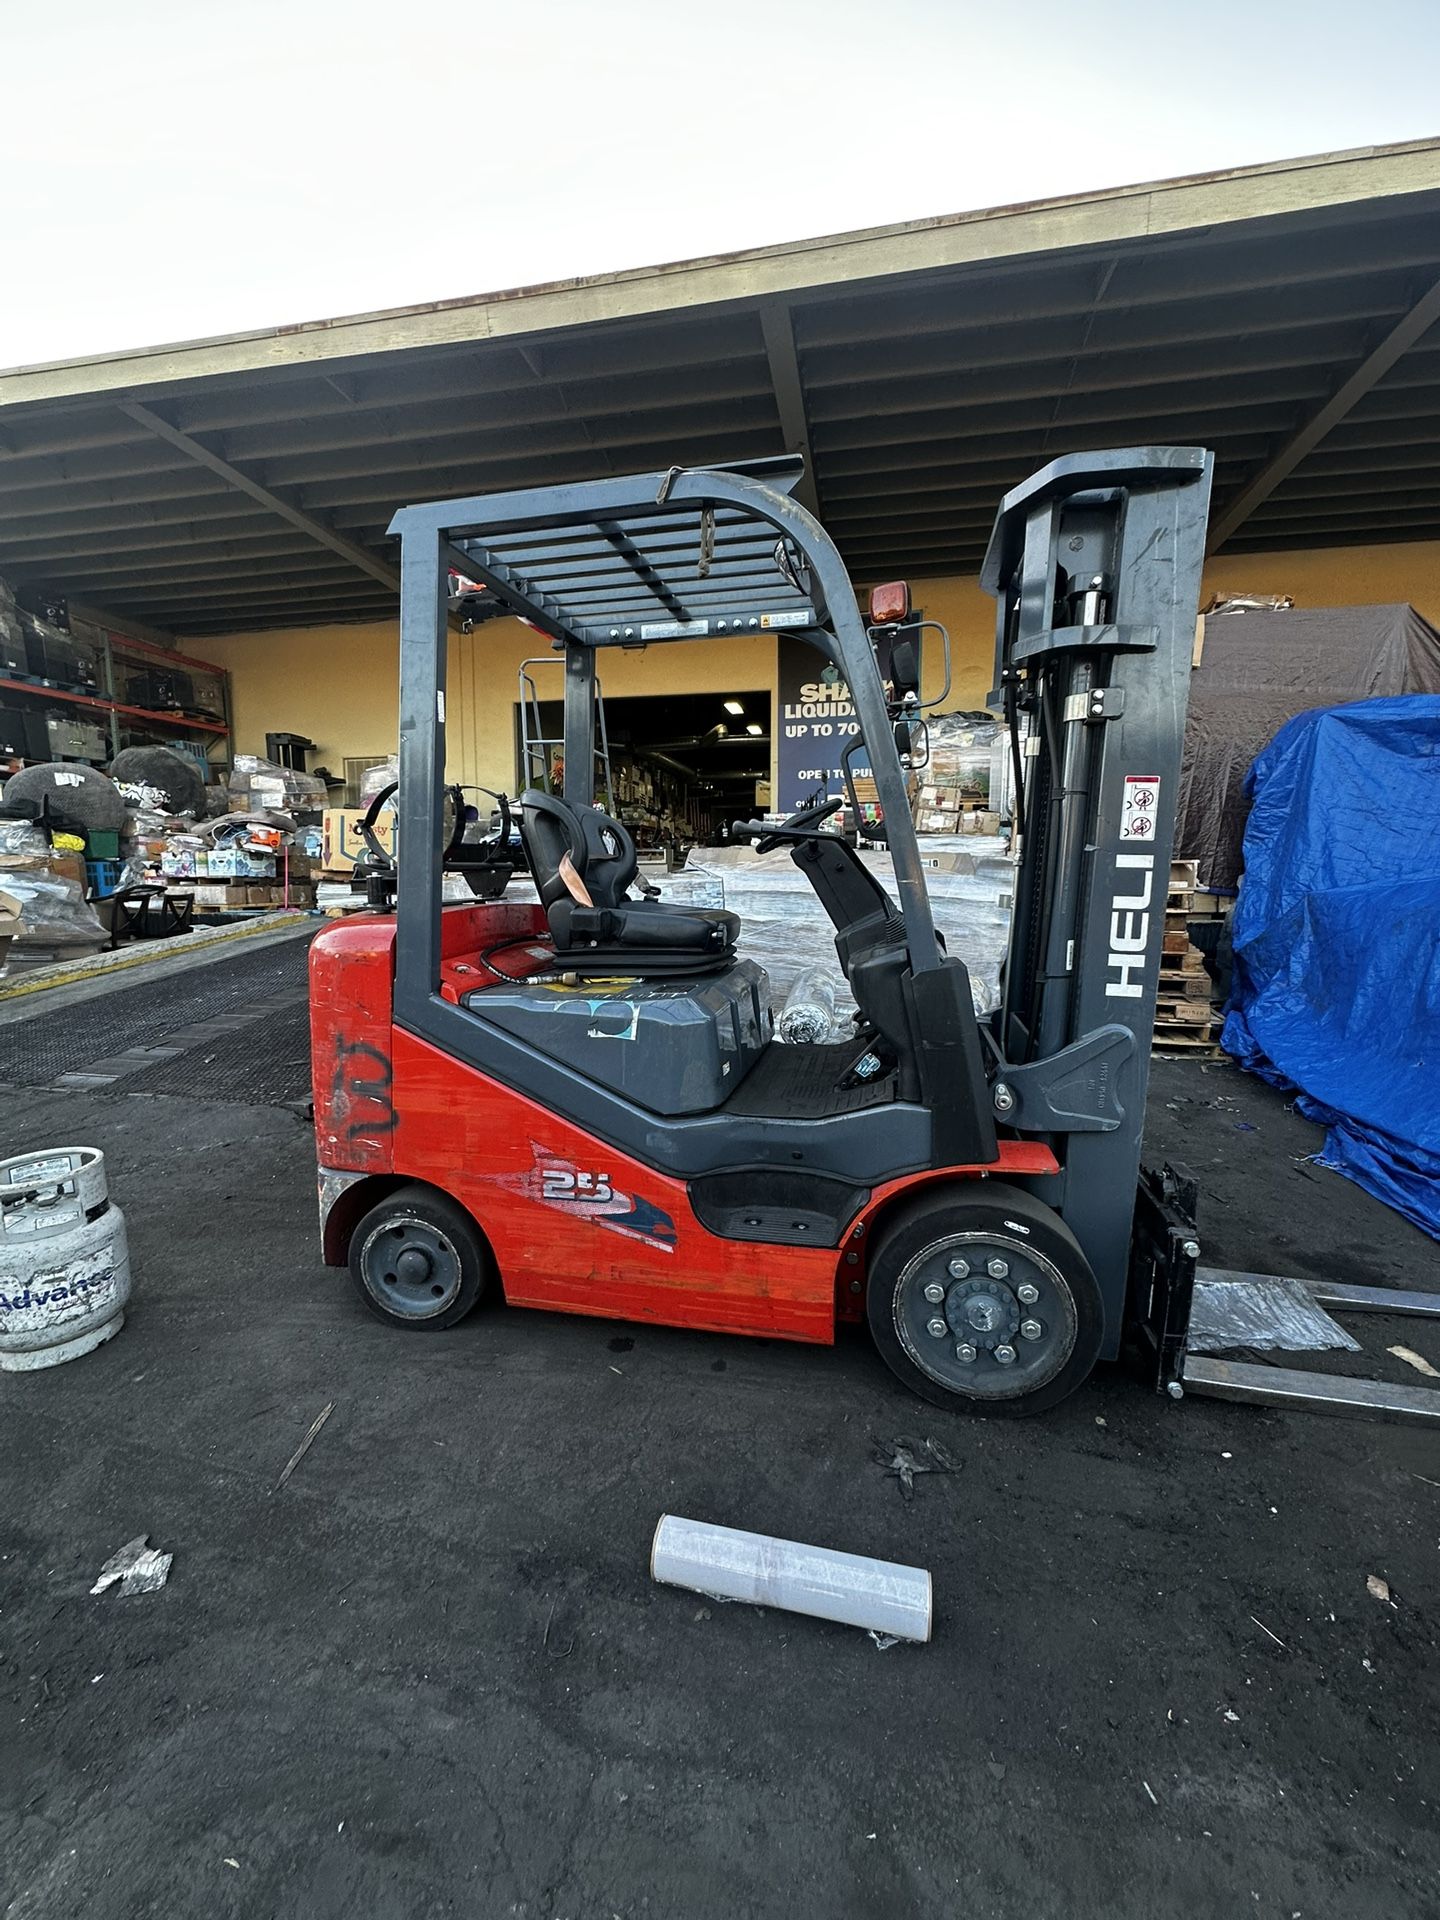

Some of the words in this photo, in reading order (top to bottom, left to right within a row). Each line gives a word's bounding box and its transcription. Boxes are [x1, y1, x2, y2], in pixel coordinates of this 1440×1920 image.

[785, 726, 808, 738] UP
[811, 723, 833, 737] TO
[1105, 854, 1155, 998] HELI
[542, 1170, 614, 1203] 25
